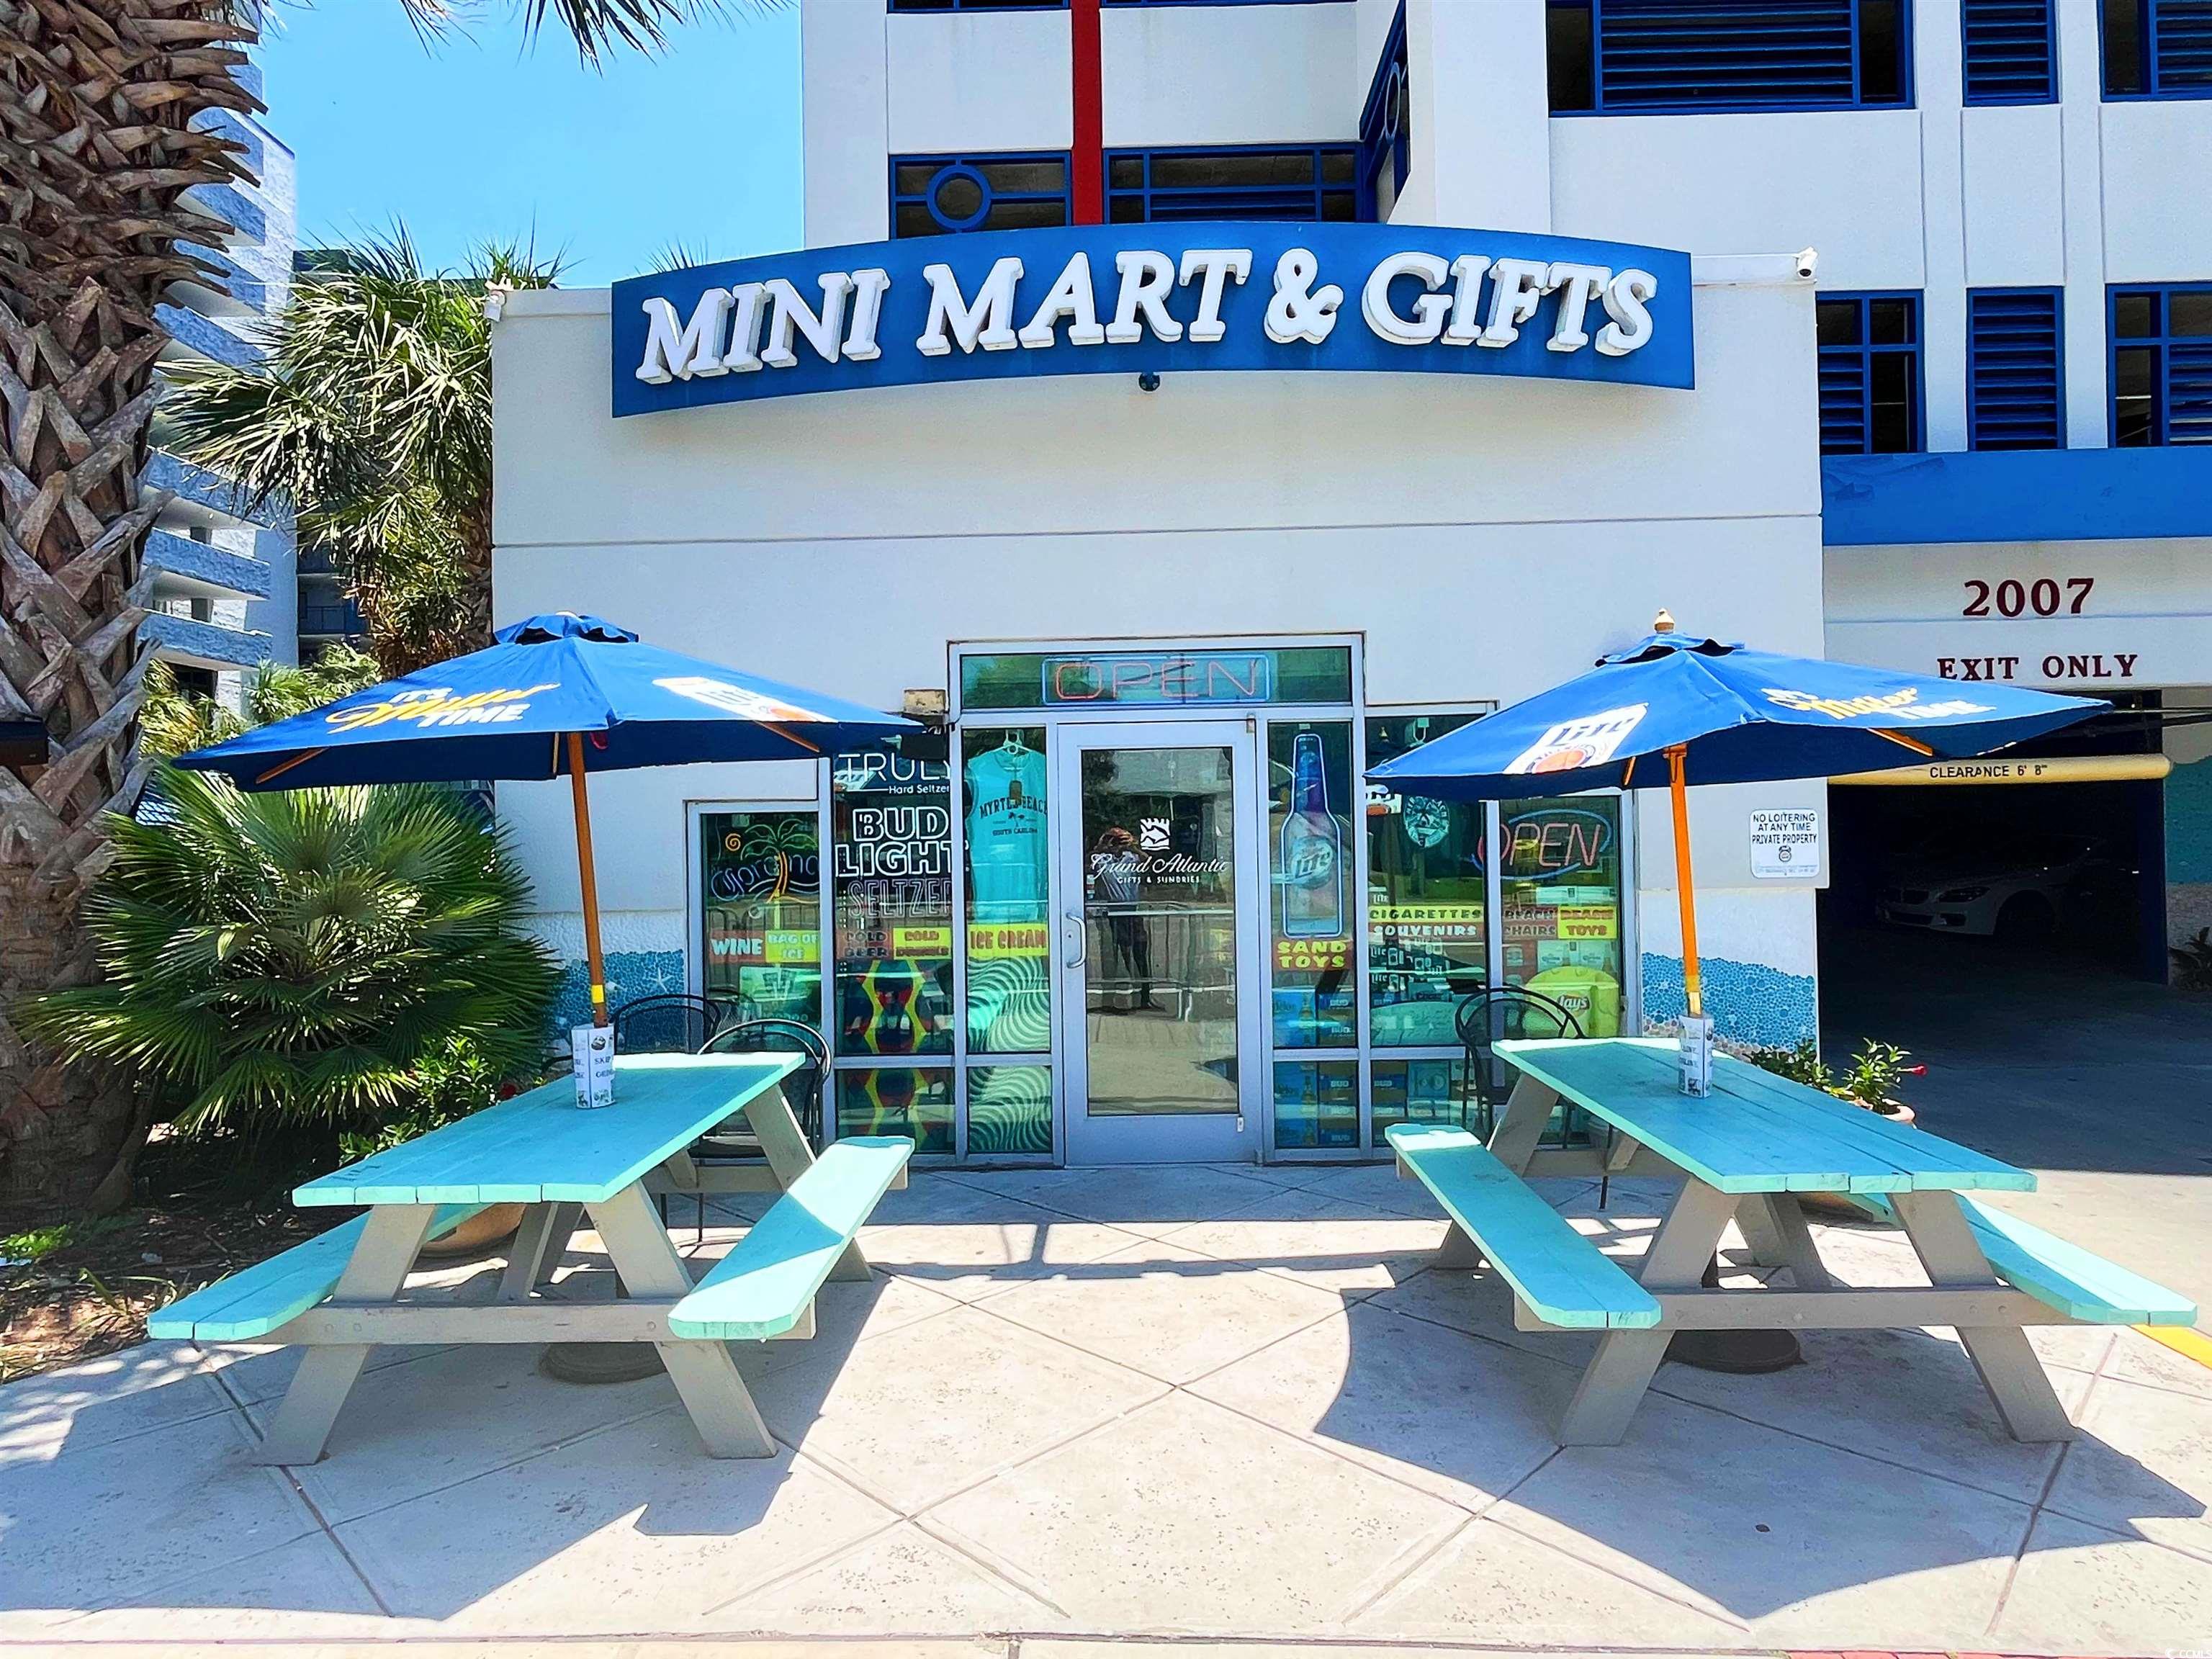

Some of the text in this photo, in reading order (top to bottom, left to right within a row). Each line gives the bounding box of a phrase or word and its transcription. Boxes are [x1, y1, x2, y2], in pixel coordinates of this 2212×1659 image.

[635, 248, 1658, 385] MINI MART & GIFTS
[1962, 577, 2095, 617] 2007
[1937, 655, 2138, 681] EXIT ONLY
[1055, 659, 1259, 701] OPEN
[1930, 765, 2010, 778] CLEARANCE
[2018, 765, 2028, 775] 6'
[917, 784, 950, 793] Seltzer
[853, 806, 949, 842] BUD
[1753, 813, 1815, 822] NO LOITERING
[1791, 822, 1812, 831] TIME
[1752, 833, 1817, 844] PRIVATE PROPERTY
[835, 840, 952, 878] LIGHT
[1091, 853, 1228, 879] Grand Atlantic
[1157, 876, 1200, 884] SUNDRIES
[1369, 909, 1481, 920] CIGARETTES
[1373, 925, 1477, 936] SOUVENIRS
[1566, 925, 1607, 936] TOYS
[768, 934, 798, 944] BAG
[971, 929, 1046, 950] ICE CREAM
[711, 938, 763, 956] WINE
[782, 948, 804, 959] ICE
[1277, 940, 1346, 954] SAND
[1279, 955, 1345, 968] TOYS
